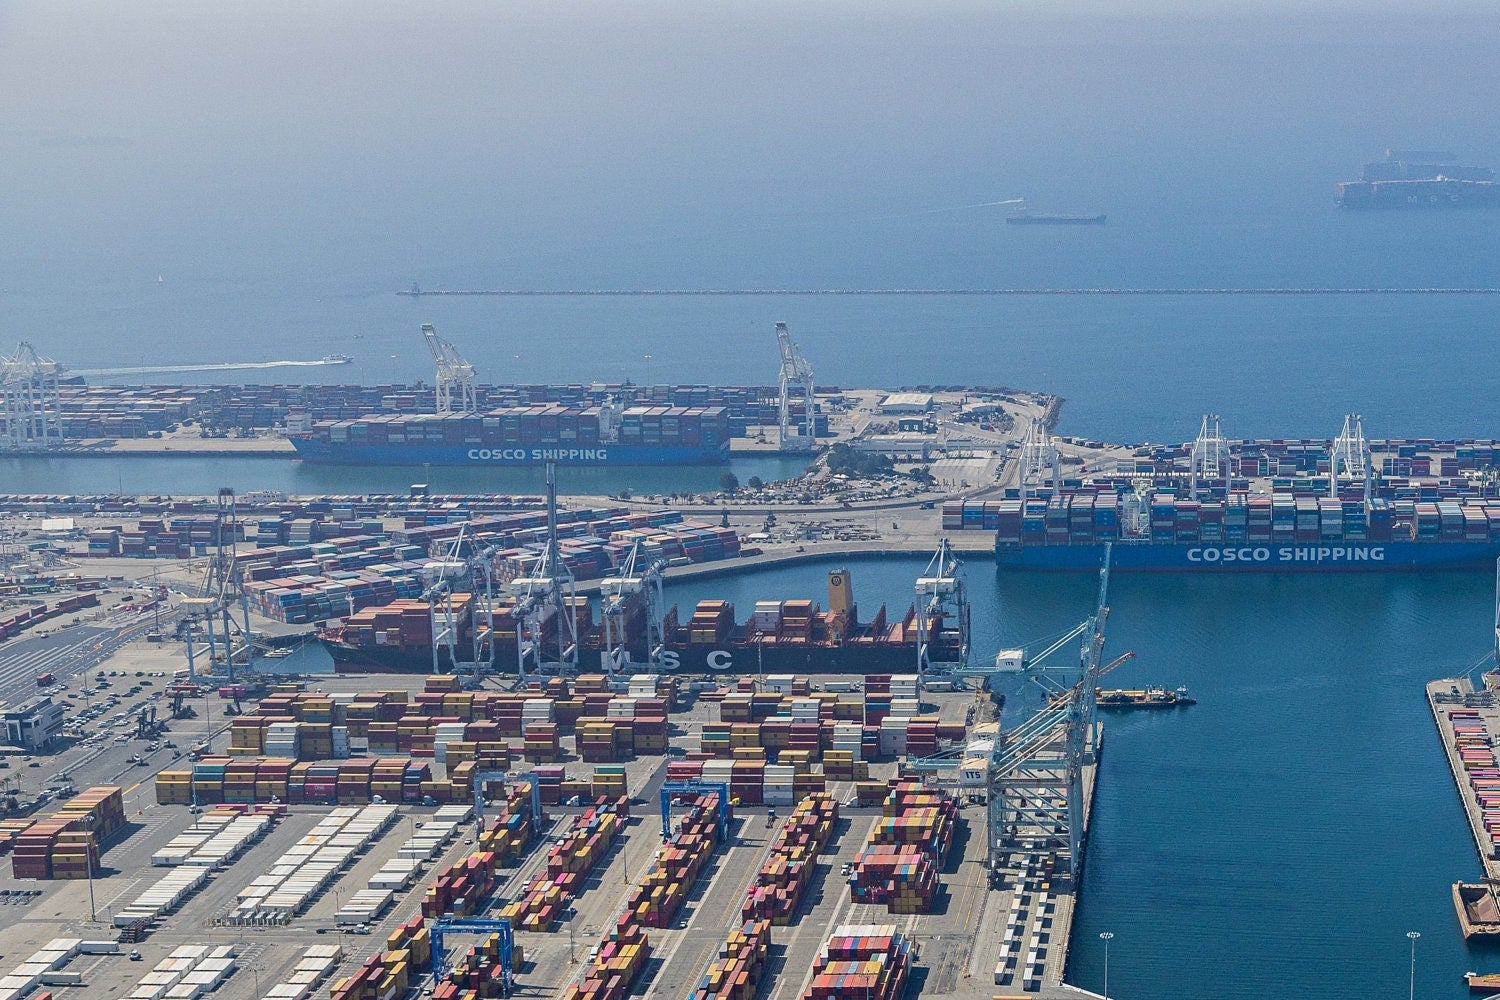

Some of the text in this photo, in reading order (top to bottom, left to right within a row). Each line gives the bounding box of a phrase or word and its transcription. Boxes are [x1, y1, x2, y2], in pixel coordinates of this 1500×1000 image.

[467, 448, 607, 460] COSCO SHIPPING
[1187, 548, 1385, 562] COSCO SHIPPING
[965, 771, 981, 780] ITS
